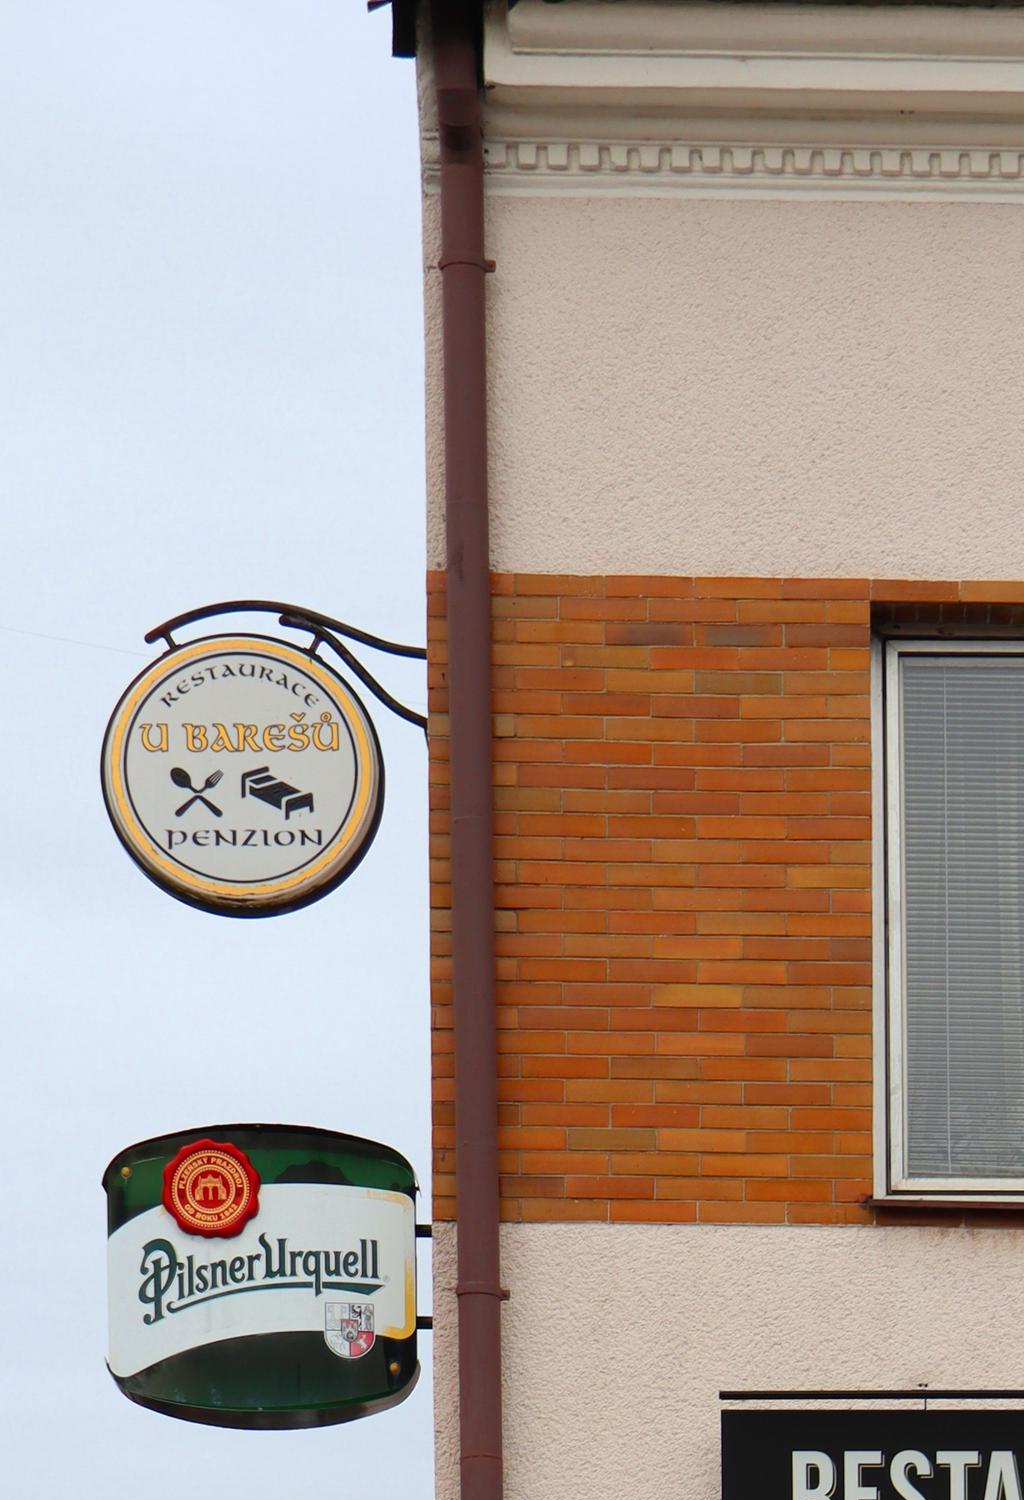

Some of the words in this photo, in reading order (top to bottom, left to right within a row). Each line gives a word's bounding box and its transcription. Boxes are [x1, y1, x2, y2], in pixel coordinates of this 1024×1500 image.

[160, 664, 320, 708] RESTAURACE
[139, 723, 169, 752] U
[182, 712, 340, 752] BAREŠŮ
[165, 829, 322, 850] PENZION
[138, 1238, 261, 1326] Pilsner
[258, 1232, 380, 1297] Urquell
